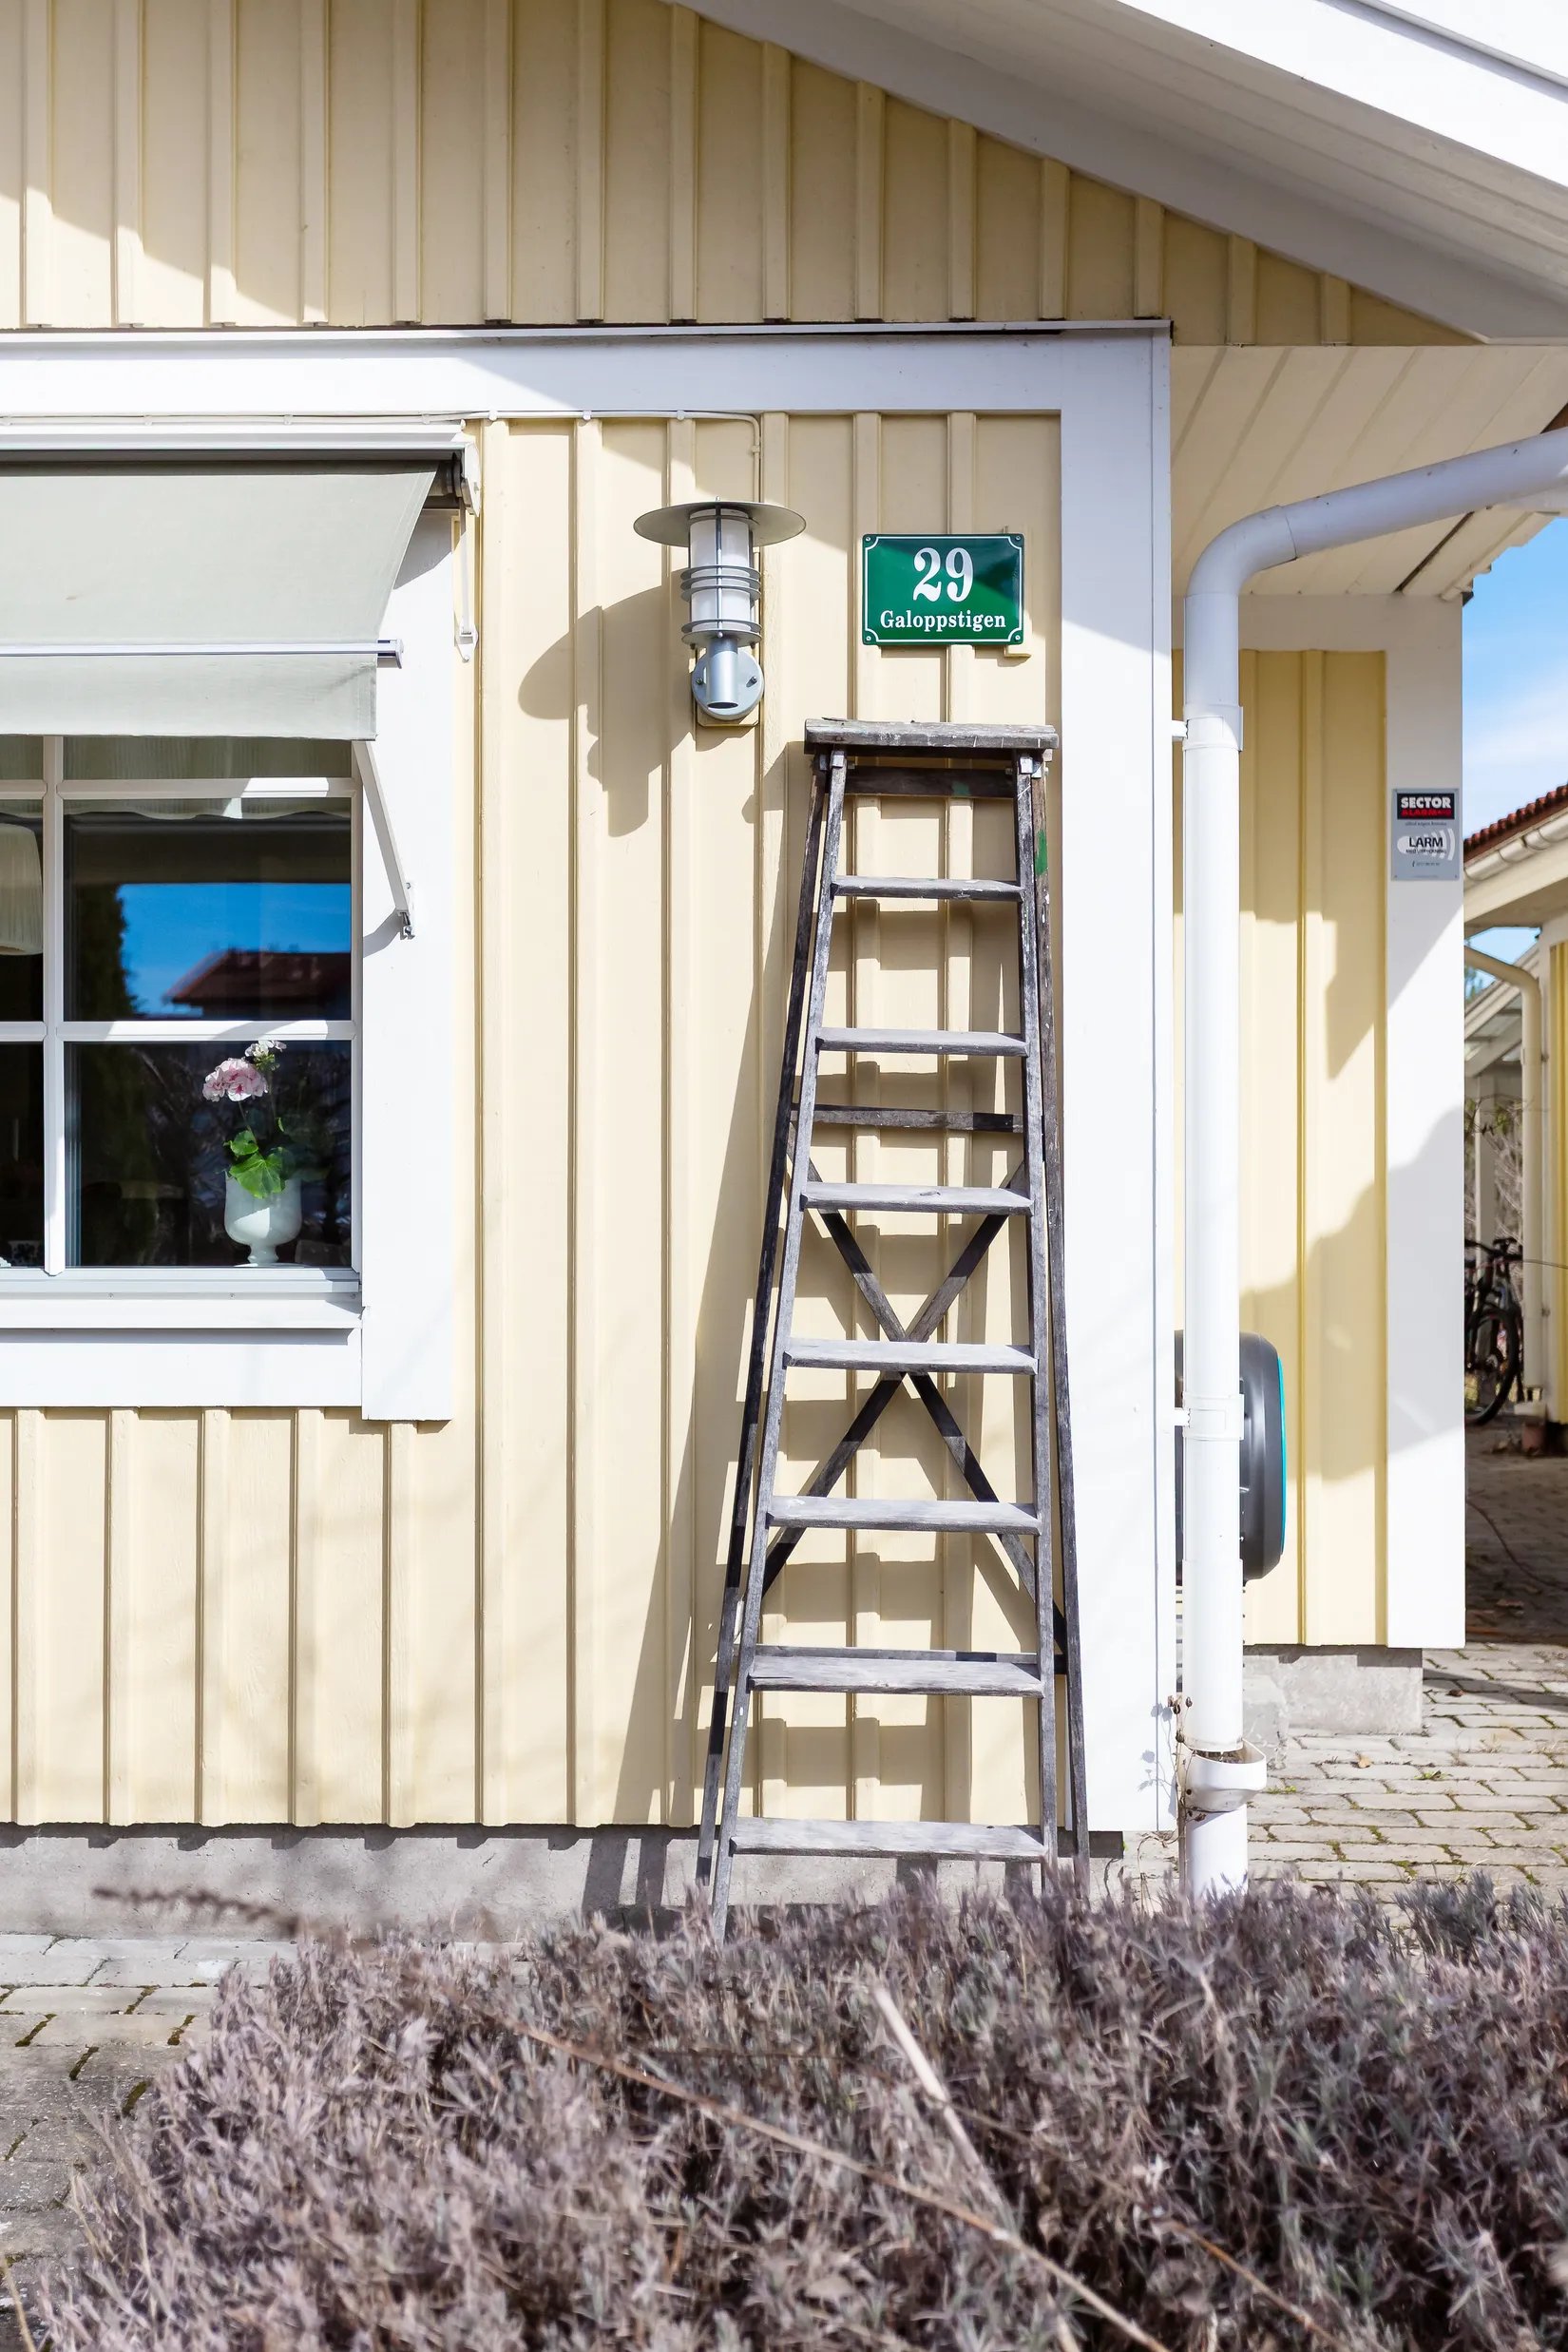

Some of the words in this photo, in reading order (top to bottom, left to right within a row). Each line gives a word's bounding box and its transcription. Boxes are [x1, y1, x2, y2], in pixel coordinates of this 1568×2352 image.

[912, 547, 974, 602] 29
[880, 609, 1006, 632] Galoppstigen
[1401, 796, 1451, 809] SECTOR
[1408, 836, 1444, 848] LARM
